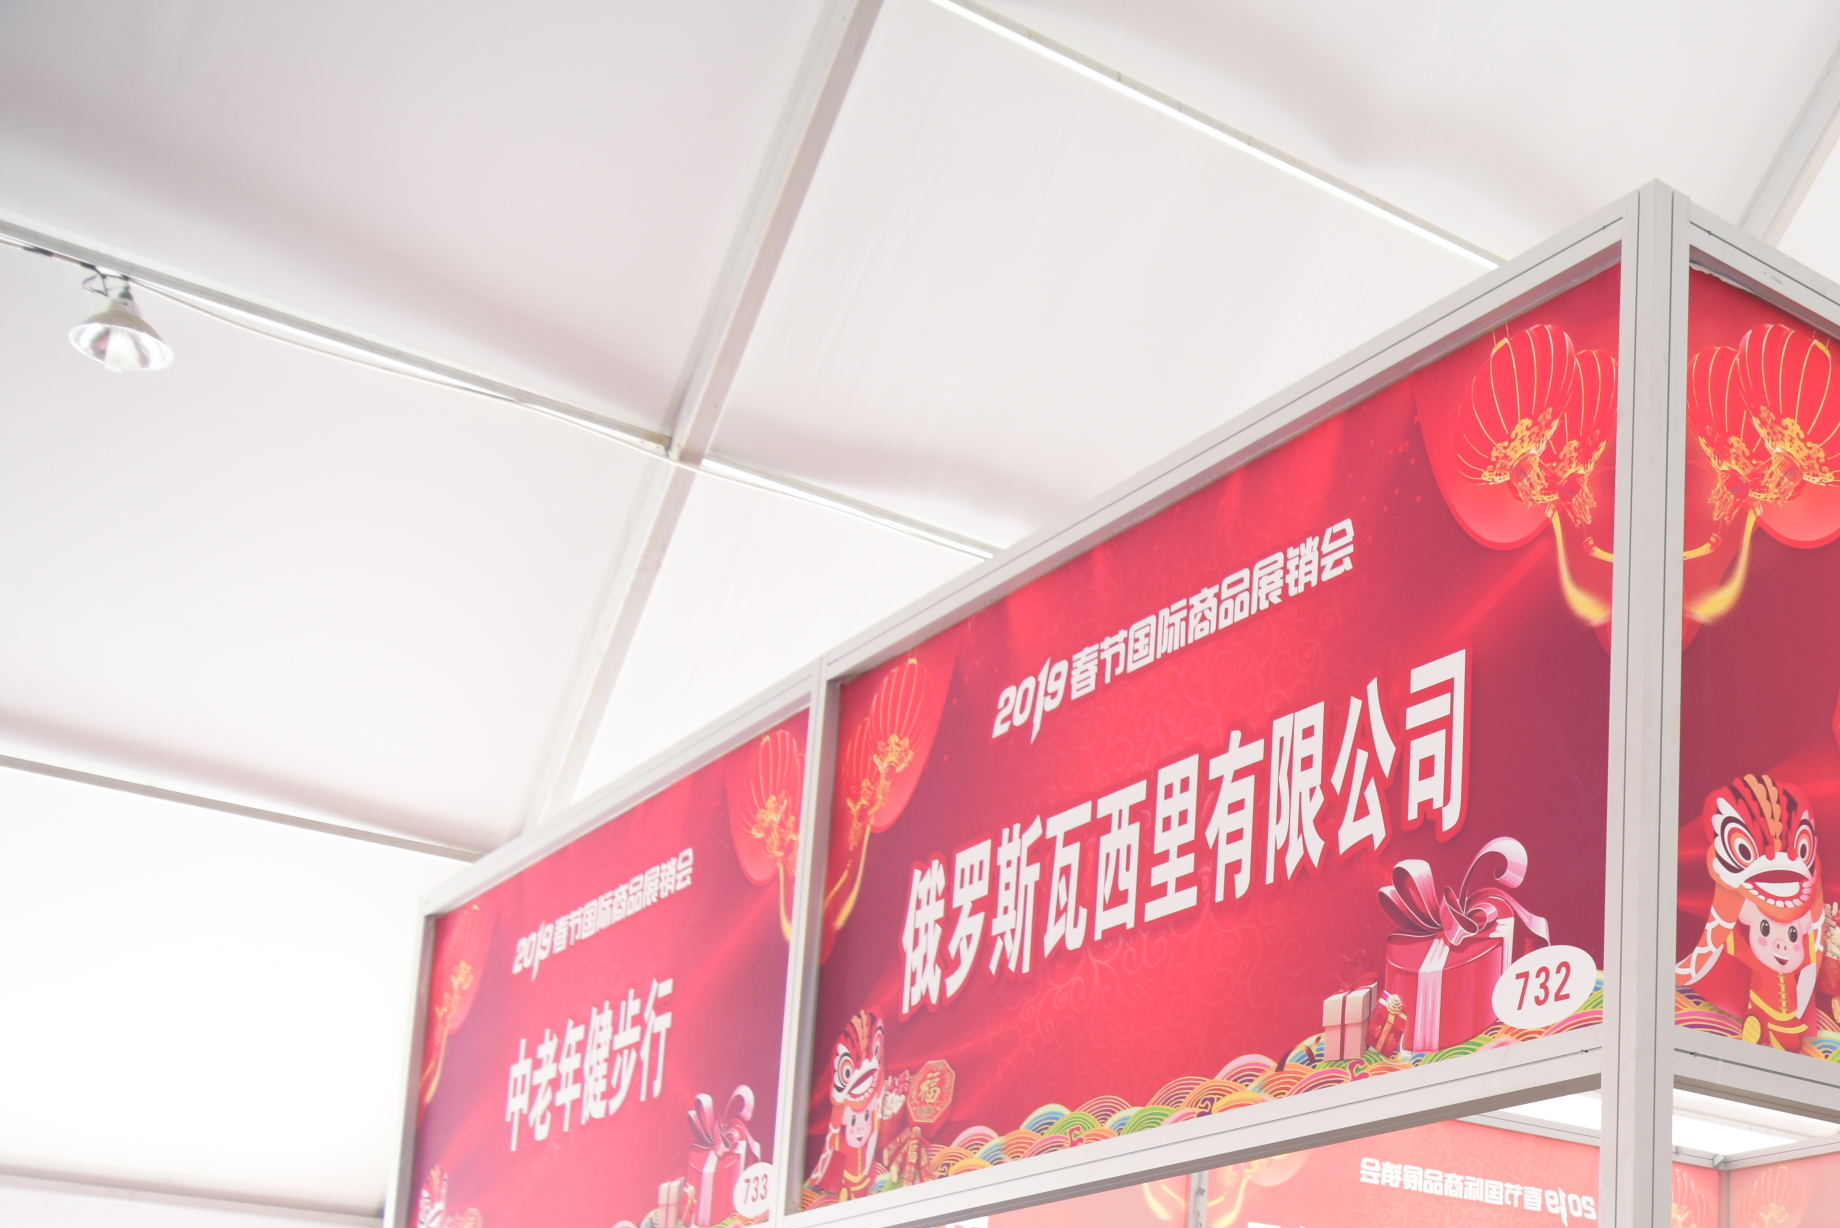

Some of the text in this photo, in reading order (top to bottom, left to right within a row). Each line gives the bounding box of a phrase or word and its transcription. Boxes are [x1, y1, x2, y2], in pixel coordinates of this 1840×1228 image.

[992, 517, 1355, 744] 2019春节国际商品展销会
[900, 647, 1468, 1016] 俄罗斯瓦西里有限公司
[511, 847, 695, 981] 2019春节国际商品展销会
[1513, 960, 1572, 1011] 732
[505, 977, 674, 1152] 中老年健步行
[744, 1173, 768, 1205] 733
